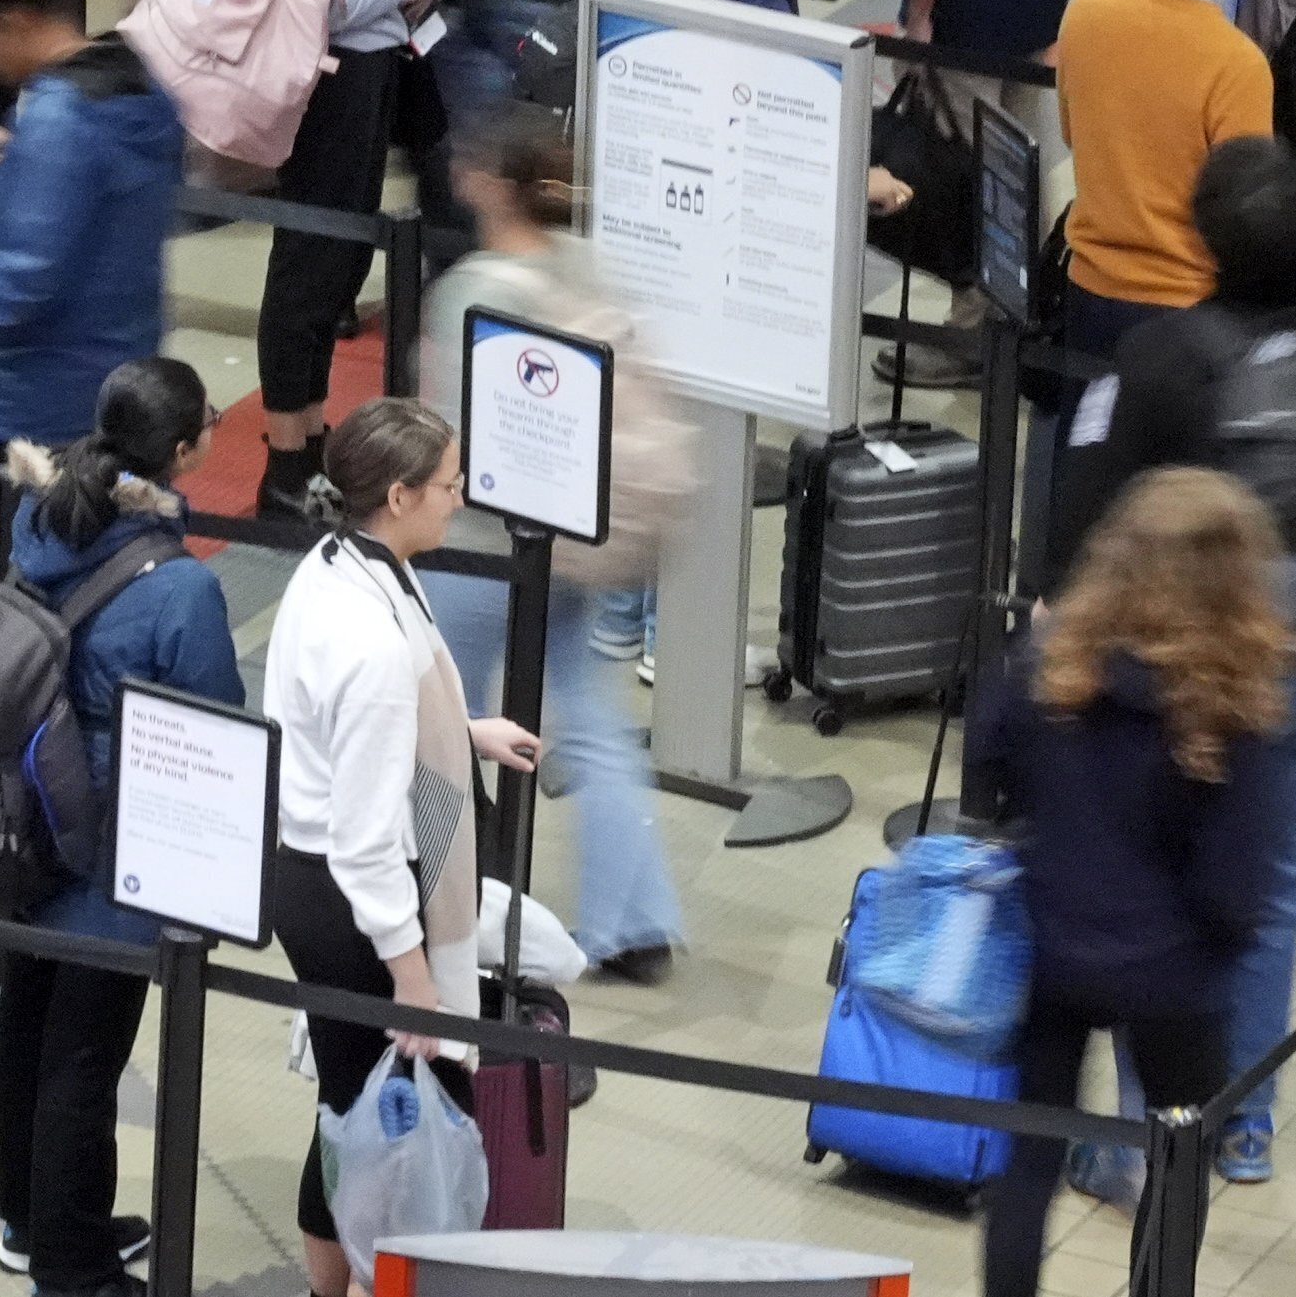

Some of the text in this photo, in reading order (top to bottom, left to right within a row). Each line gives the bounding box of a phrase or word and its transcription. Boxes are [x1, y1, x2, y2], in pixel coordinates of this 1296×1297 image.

[493, 389, 580, 427] Do not bring your
[497, 404, 577, 439] firearm through
[499, 419, 515, 434] the
[132, 708, 188, 734] No threats.
[131, 725, 147, 740] No
[148, 731, 181, 750] verbal
[129, 756, 141, 771] of
[142, 761, 162, 777] any
[130, 743, 235, 782] No physical violence
